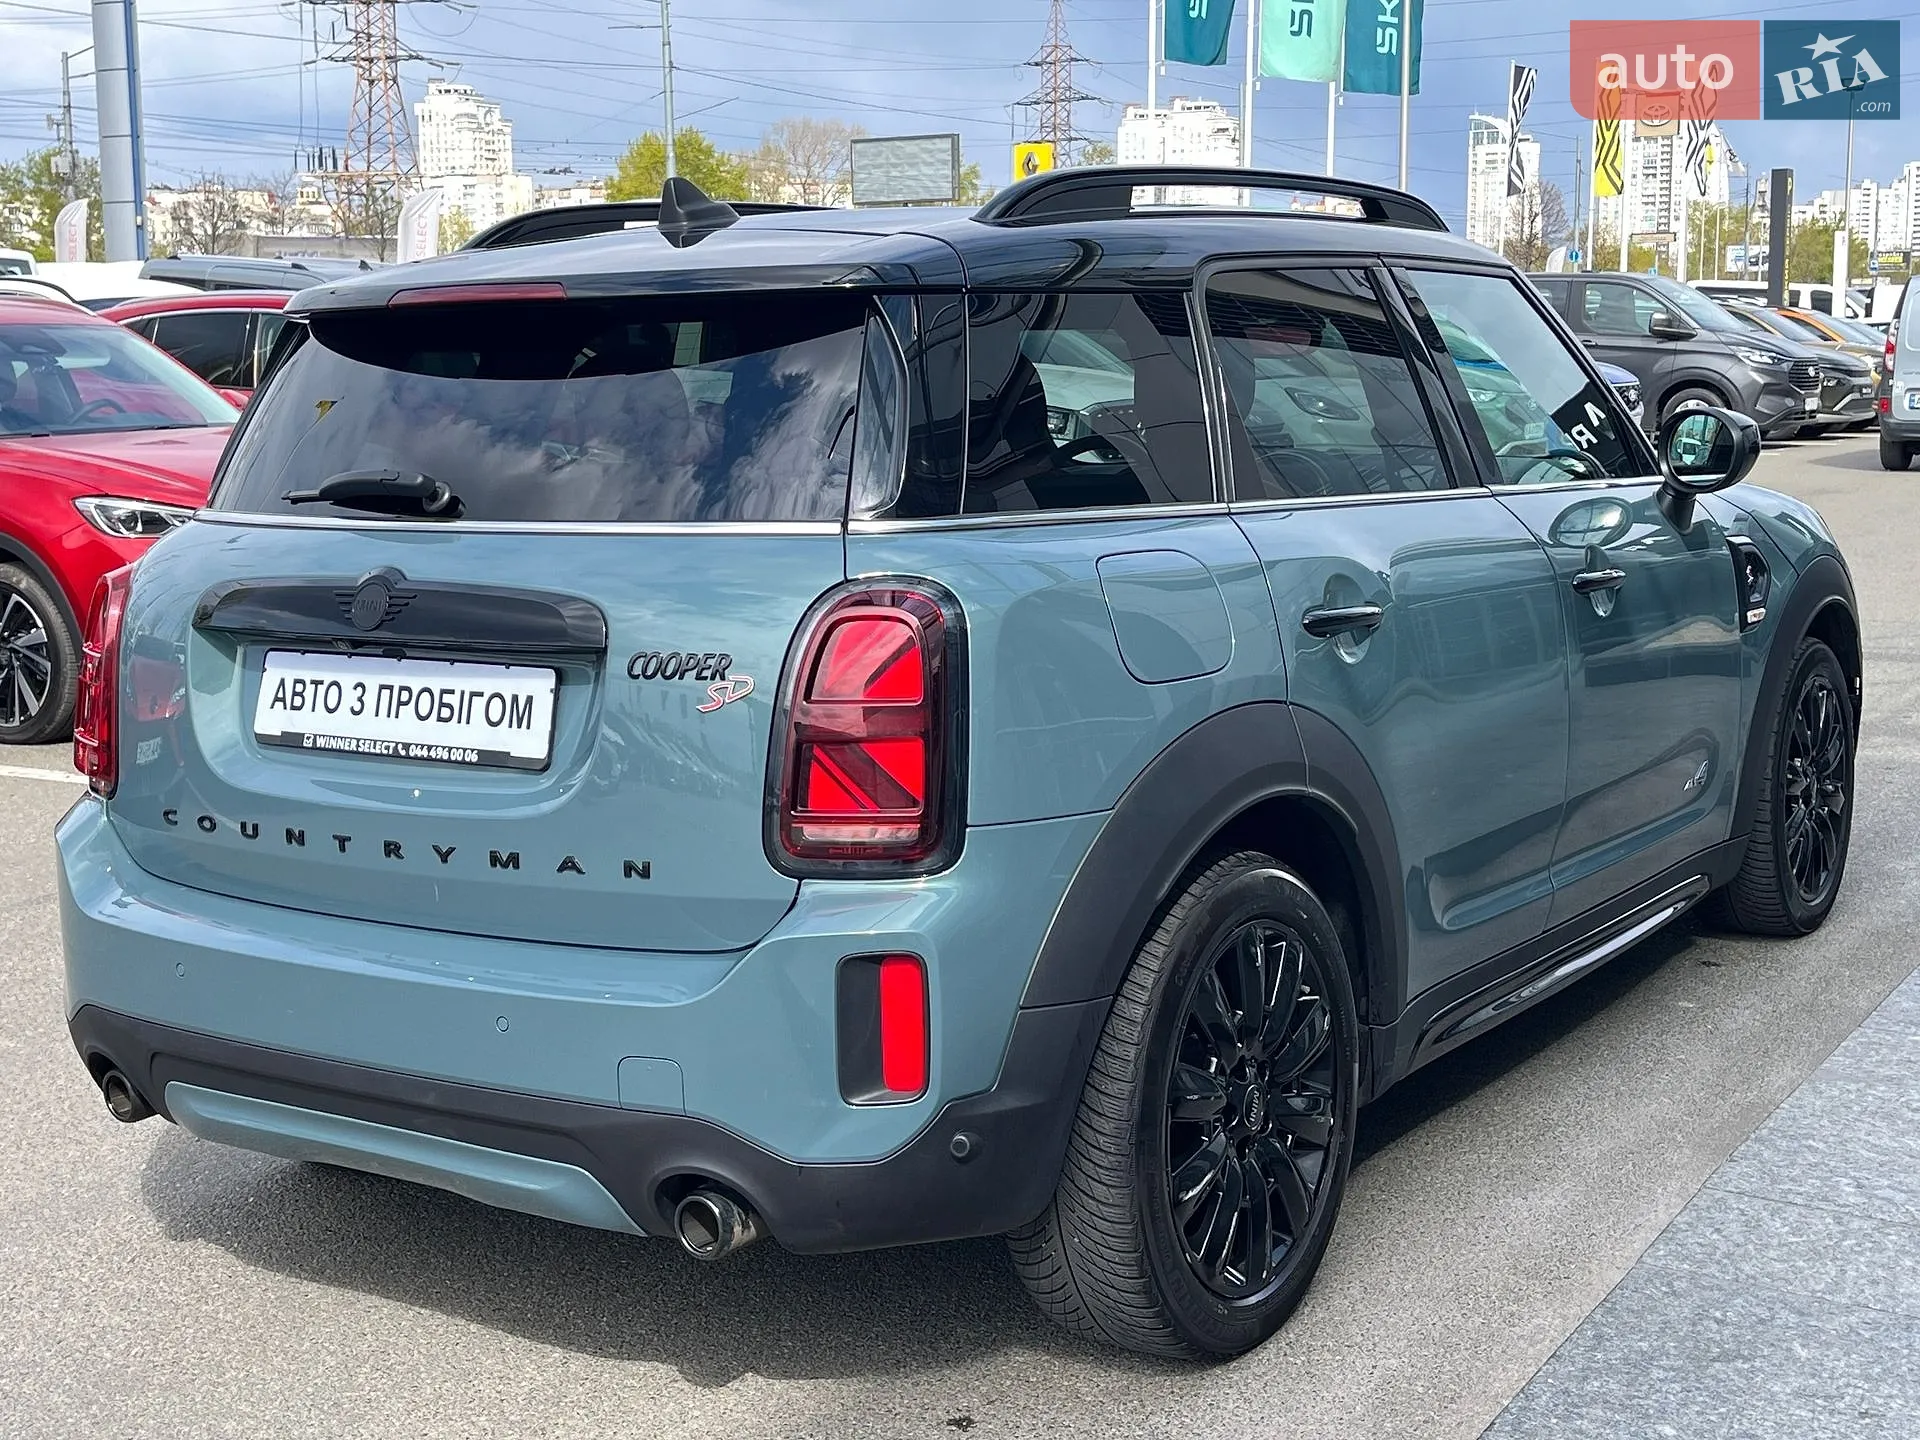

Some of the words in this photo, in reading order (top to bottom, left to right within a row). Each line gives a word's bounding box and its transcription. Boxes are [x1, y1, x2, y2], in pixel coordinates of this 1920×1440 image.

[1289, 0, 1314, 39] S
[356, 599, 385, 612] MINI
[627, 651, 733, 681] COOPER
[270, 677, 342, 714] АВТО
[375, 684, 534, 730] ПРОБІГОМ
[696, 675, 755, 713] SD
[316, 735, 357, 751] WINNER
[358, 739, 396, 755] SELECT
[409, 744, 428, 758] 044
[429, 746, 449, 760] 496
[450, 748, 464, 761] 00
[464, 749, 479, 763] 06
[162, 808, 651, 880] COUNTRYMAN
[1249, 1090, 1260, 1122] MINI
